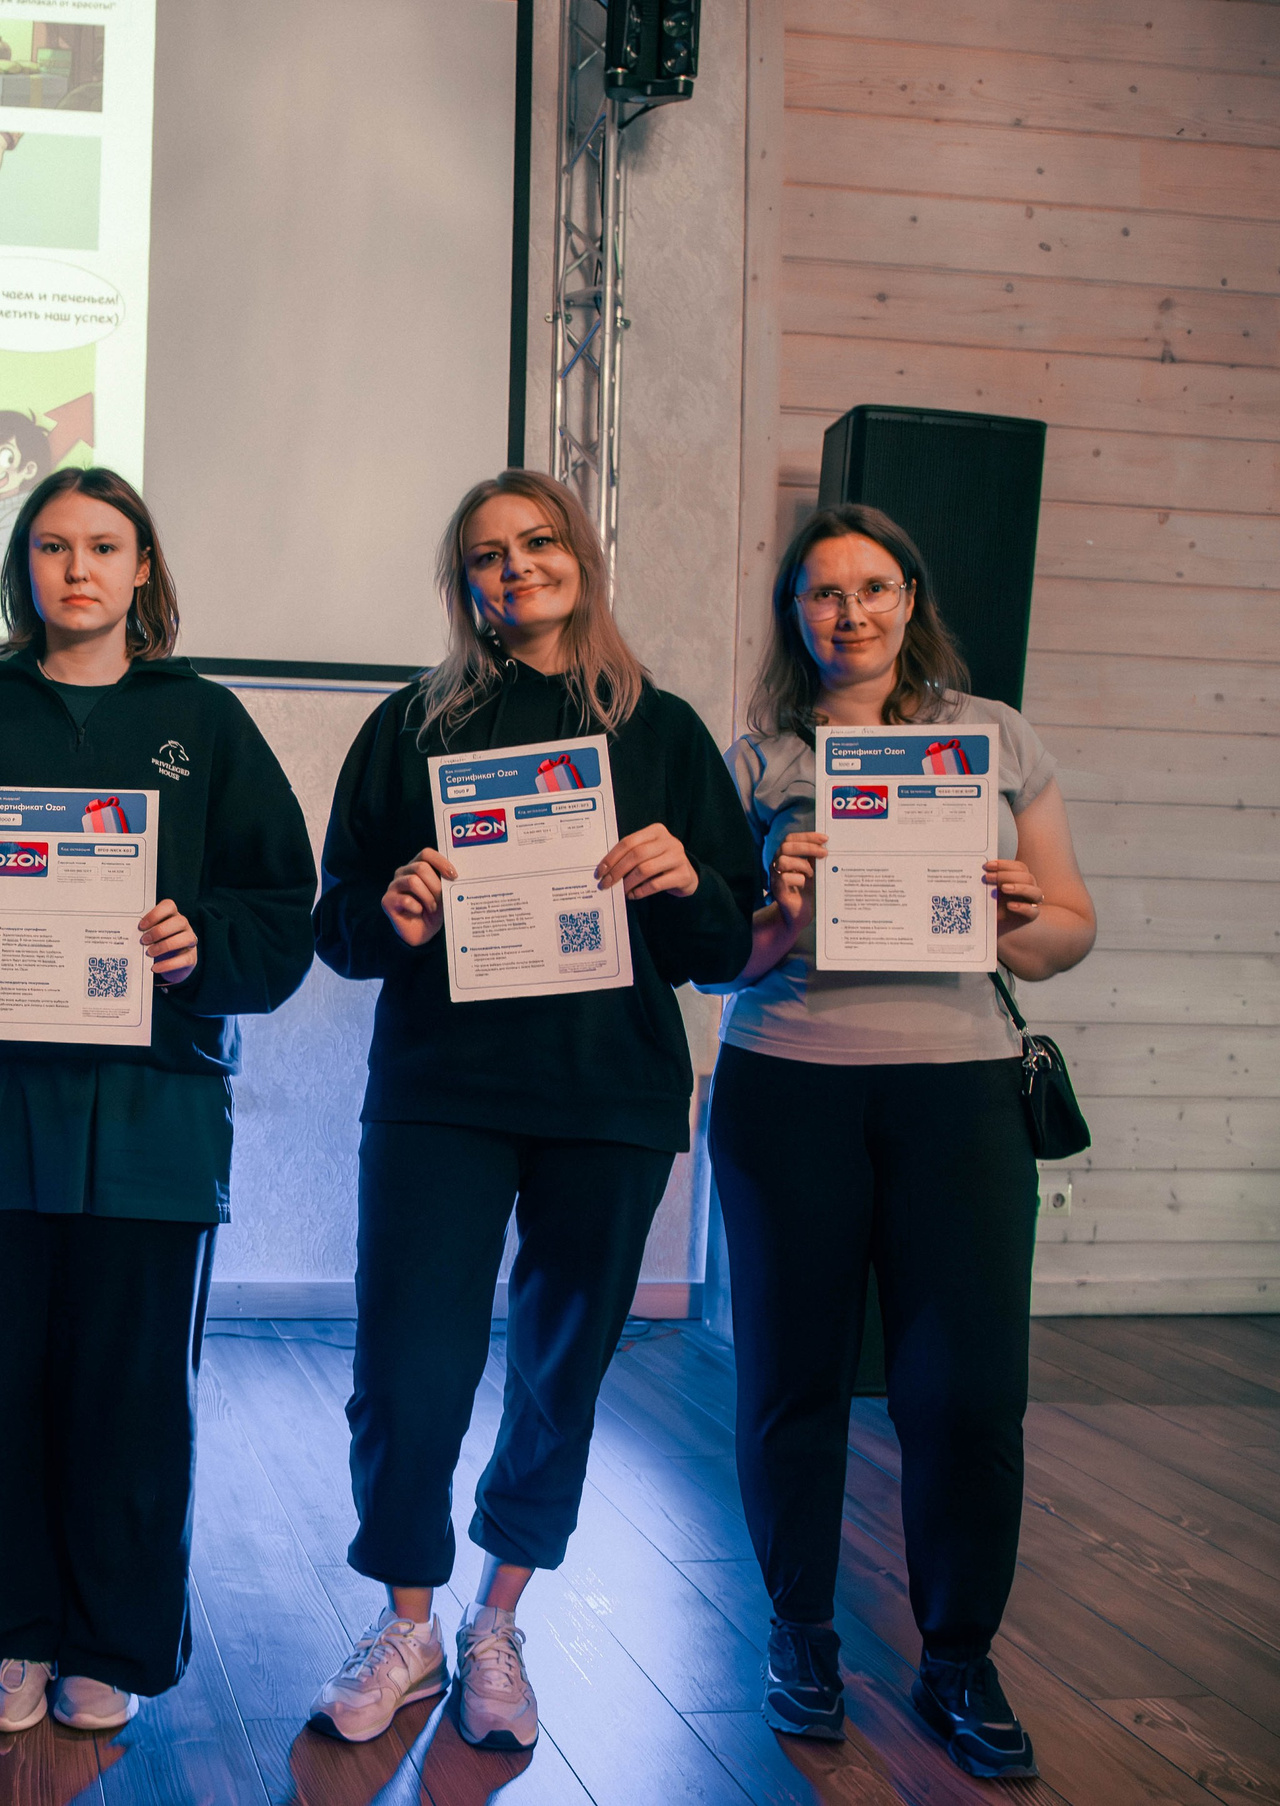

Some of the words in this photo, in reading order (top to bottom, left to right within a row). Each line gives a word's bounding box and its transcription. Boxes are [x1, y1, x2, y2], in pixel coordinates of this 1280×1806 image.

[2, 291, 34, 300] чаем
[38, 293, 47, 301] и
[52, 293, 119, 306] печеньем!
[44, 312, 71, 322] наш
[74, 313, 120, 326] успех)
[832, 748, 882, 757] Сертификат
[884, 747, 905, 755] Ozon
[151, 757, 190, 777] PRIVILEGED
[159, 767, 180, 781] HOUSE
[446, 772, 495, 784] Сертификат
[497, 769, 519, 778] Ozon
[45, 803, 66, 811] Ozon
[833, 797, 887, 810] OZON
[453, 820, 506, 838] OZON
